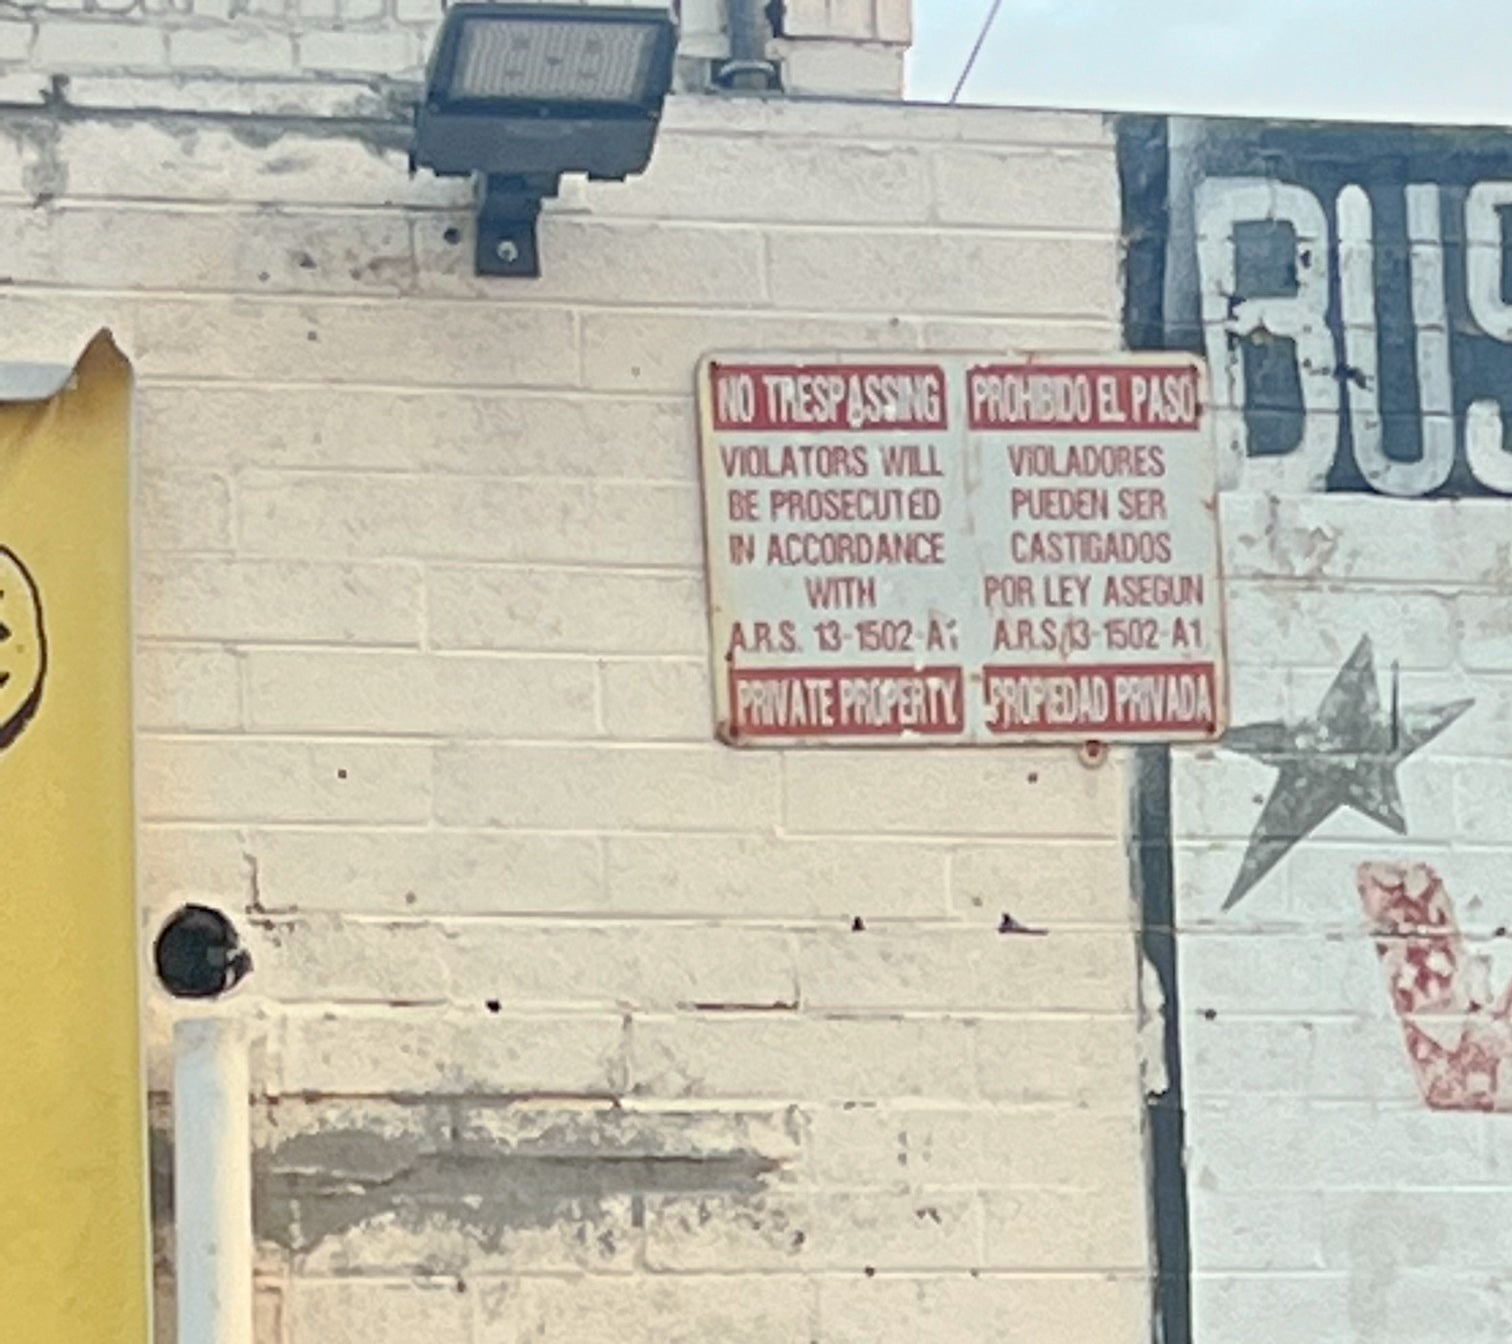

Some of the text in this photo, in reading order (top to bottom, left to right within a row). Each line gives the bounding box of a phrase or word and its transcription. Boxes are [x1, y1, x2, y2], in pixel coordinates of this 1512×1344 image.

[717, 374, 942, 427] NO TRESPASSING
[972, 374, 1195, 422] PROHIBIDO EL PASO
[719, 445, 945, 478] VIOLATORS WILL
[1007, 445, 1166, 477] VIOLADORES
[728, 488, 941, 521] BE PROSECUTED
[1011, 487, 1167, 520] PUEDEN SER
[729, 532, 946, 565] IN ACCORDANCE
[1011, 531, 1172, 564] CASTIGADOS
[804, 576, 877, 609] WITH
[984, 573, 1204, 608] POR LEY ASEGUN
[736, 676, 961, 727] PRIVATE PROPERTY
[988, 673, 1213, 728] PROPIEDAD PRIVADA
